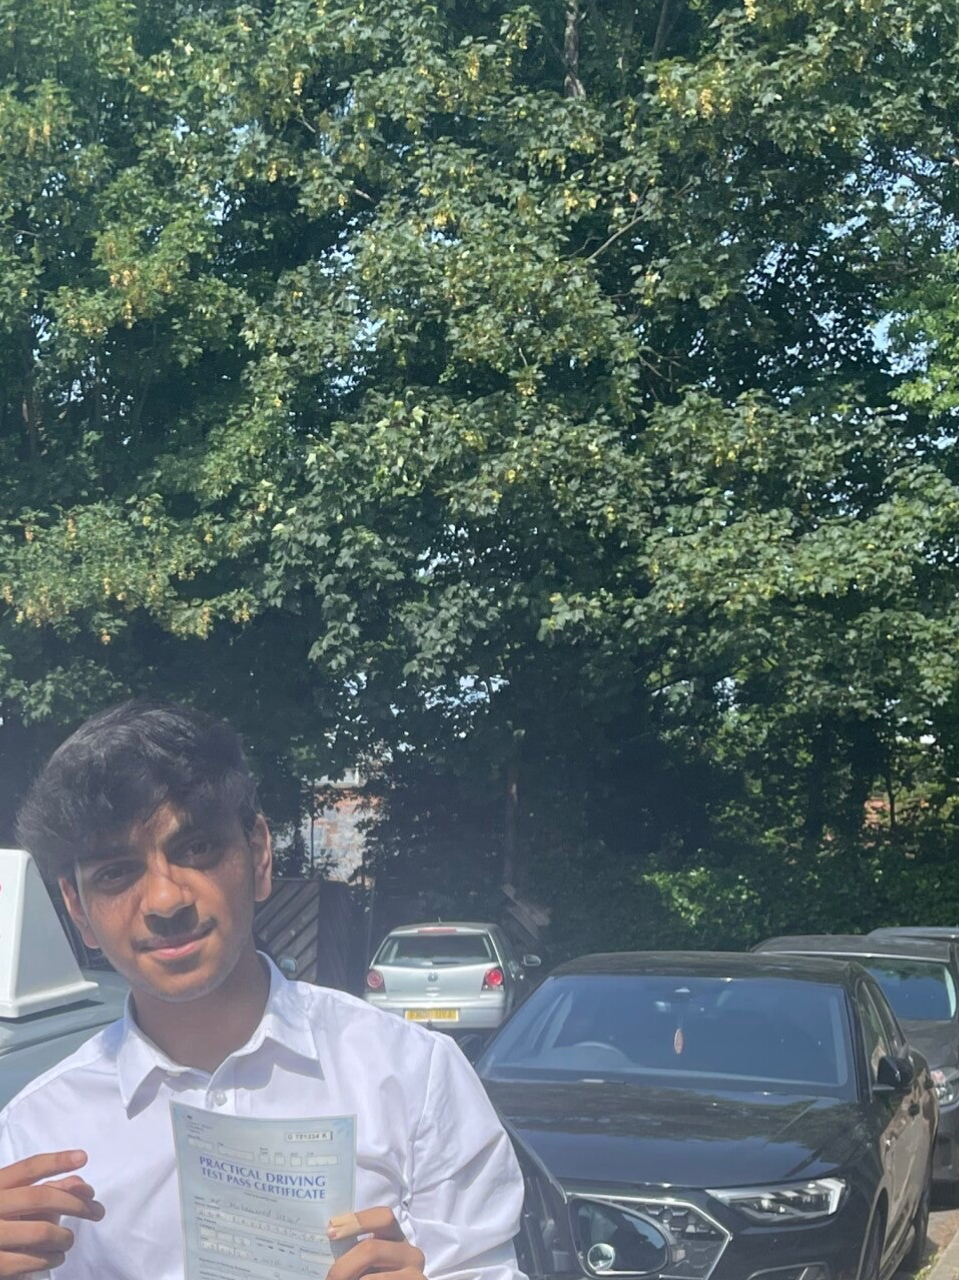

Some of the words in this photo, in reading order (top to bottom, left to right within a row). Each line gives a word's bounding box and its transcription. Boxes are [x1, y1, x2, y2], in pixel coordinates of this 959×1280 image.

[200, 1156, 261, 1180] PRACTICAL
[266, 1172, 325, 1187] DRIVING
[202, 1167, 224, 1181] TEST
[227, 1174, 252, 1188] PASS
[254, 1181, 326, 1199] CERTIFICATE
